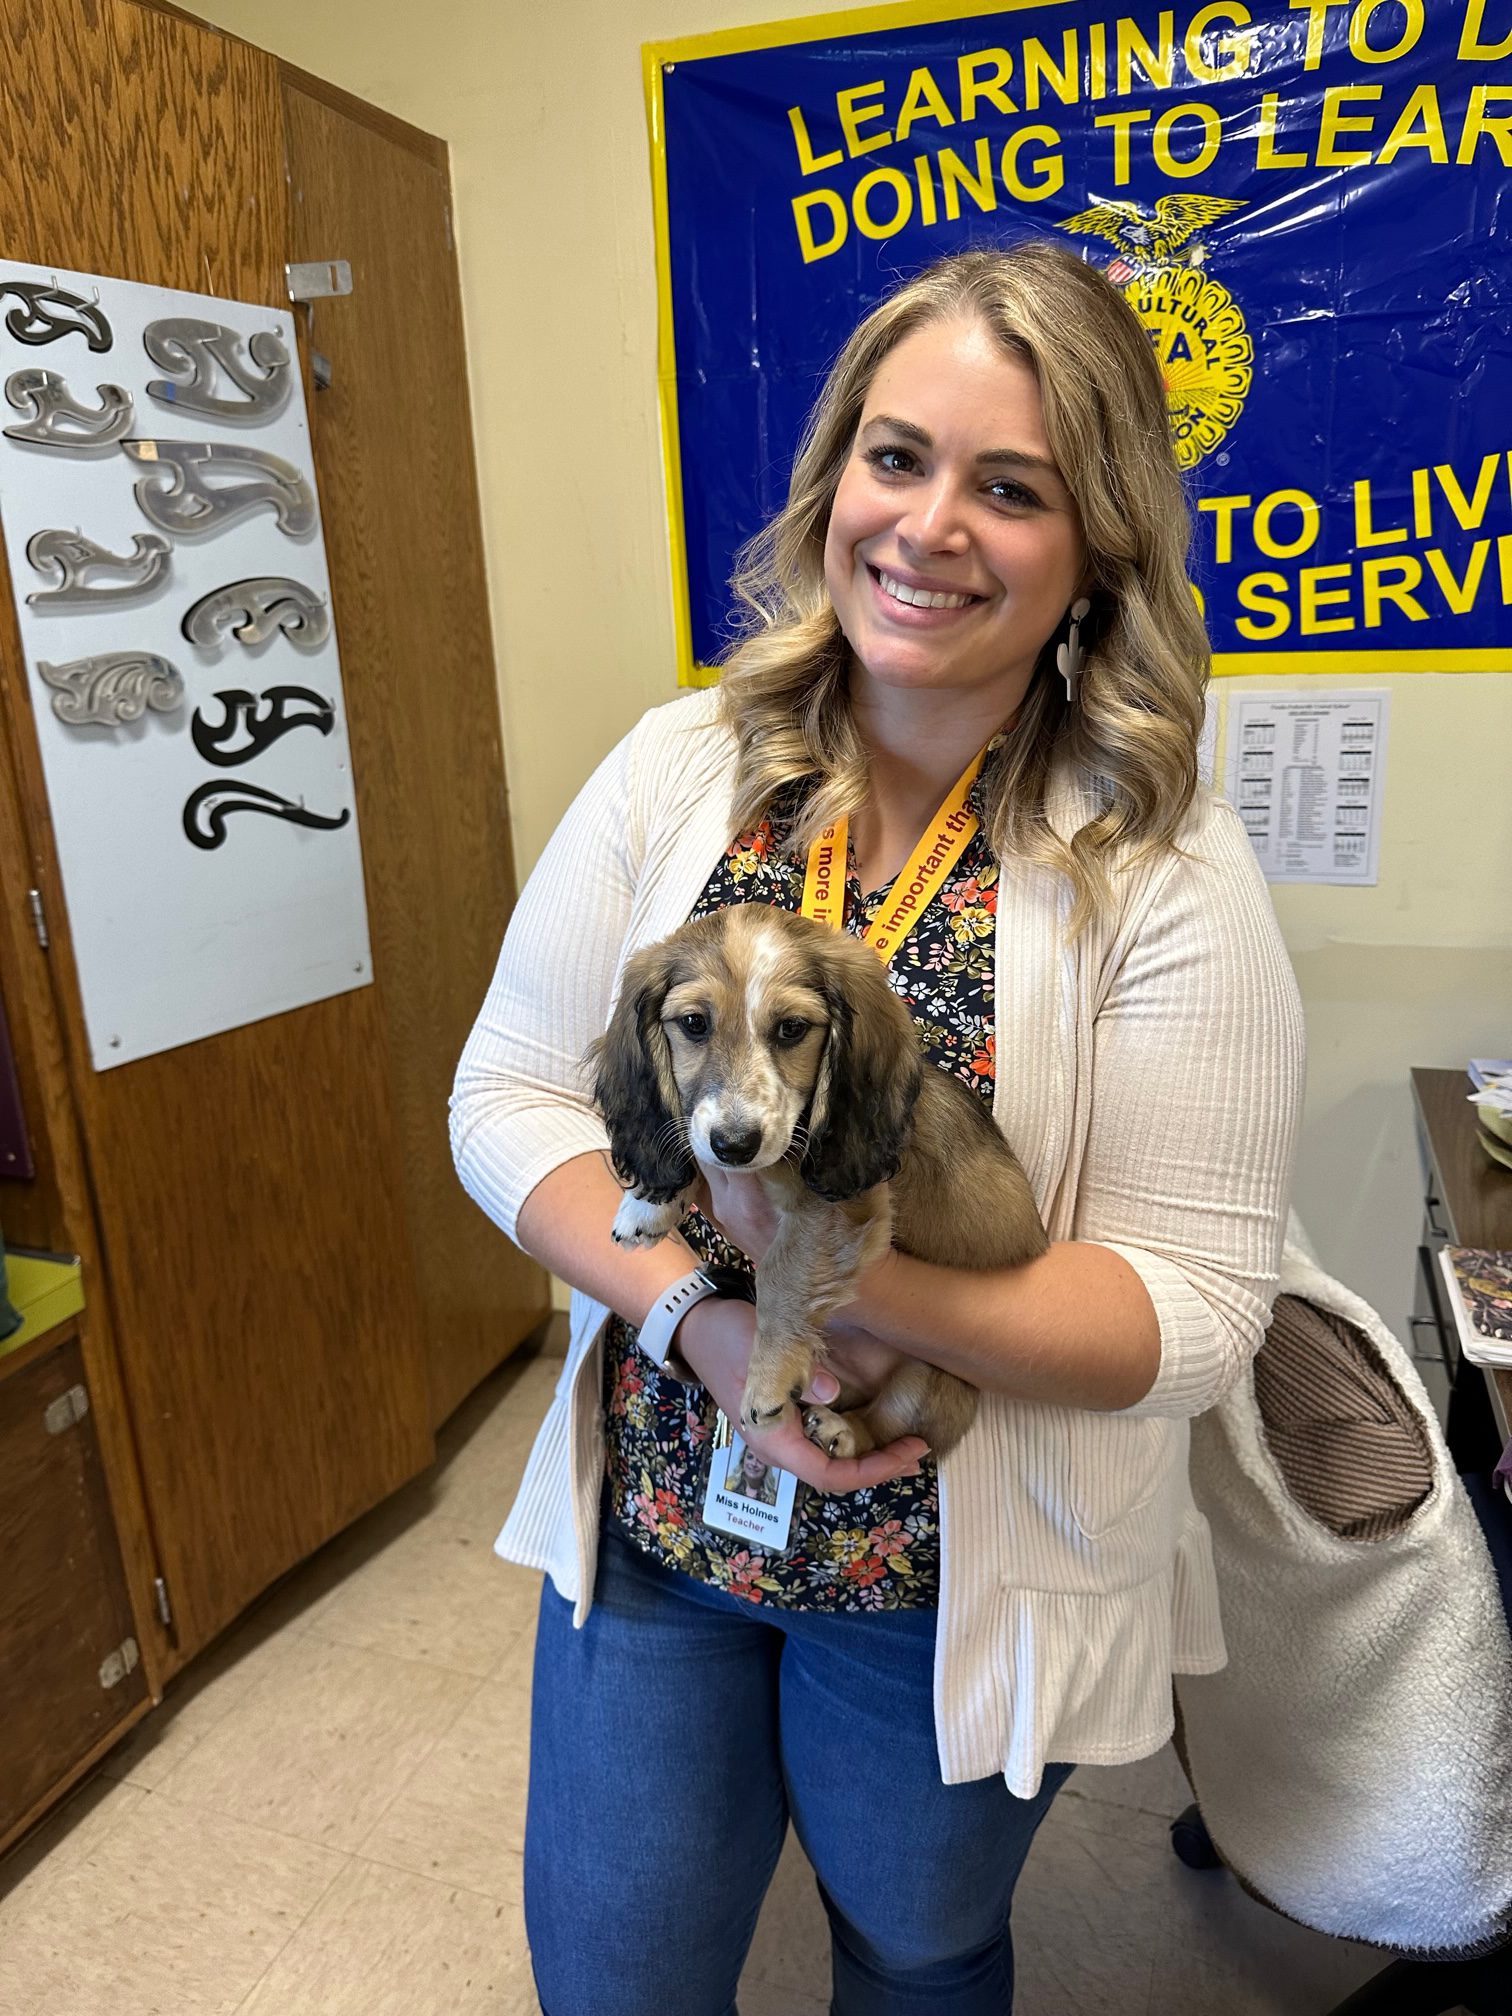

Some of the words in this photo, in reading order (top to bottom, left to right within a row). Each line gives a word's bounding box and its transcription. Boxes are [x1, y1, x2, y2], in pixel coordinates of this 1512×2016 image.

[787, 0, 1252, 176] LEARNING
[1289, 0, 1425, 71] TO
[791, 125, 1064, 264] DOING
[1095, 103, 1221, 186] TO
[1255, 84, 1512, 170] LEAR
[1138, 296, 1220, 370] ULTURAL
[1197, 489, 1320, 564] TO
[1354, 450, 1512, 548] LIV
[1235, 534, 1512, 640] SERV
[815, 846, 833, 901] more
[882, 833, 955, 933] important
[716, 1494, 738, 1509] Miss
[742, 1503, 779, 1523] Holmes
[728, 1513, 764, 1532] Teacher
